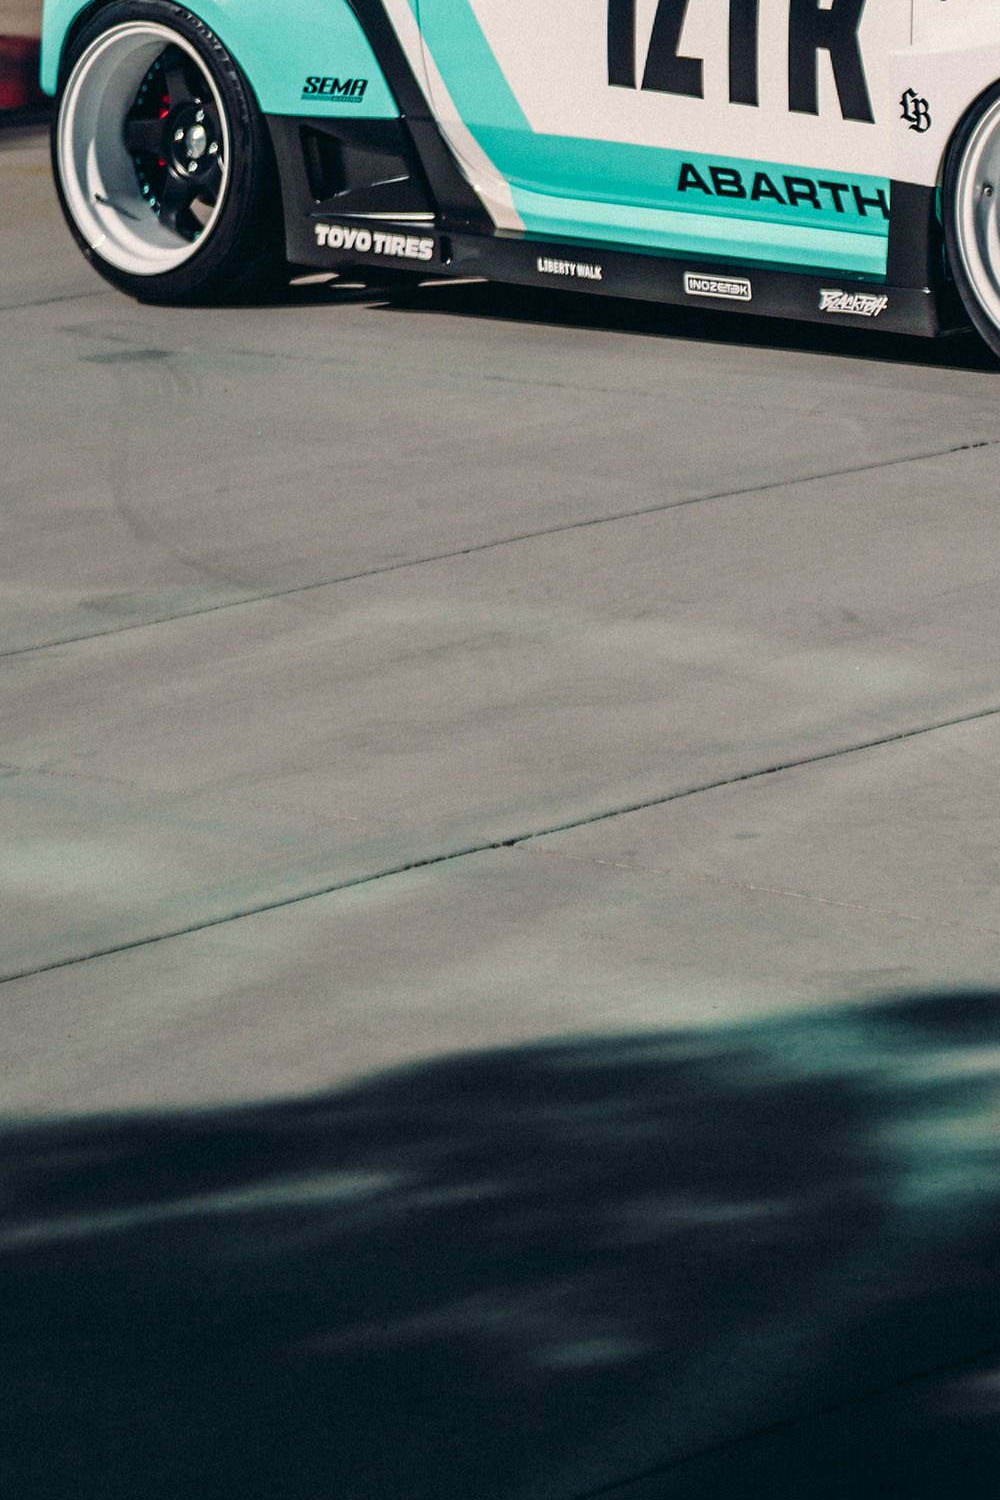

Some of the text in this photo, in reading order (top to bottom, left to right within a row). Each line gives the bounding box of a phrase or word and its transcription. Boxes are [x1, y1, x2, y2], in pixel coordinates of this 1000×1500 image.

[303, 76, 369, 96] SEMA
[677, 162, 889, 220] ABARTH
[315, 223, 434, 260] TOYO TIRES
[537, 257, 602, 280] LIBERTY WALK
[689, 278, 748, 296] INOZETEK
